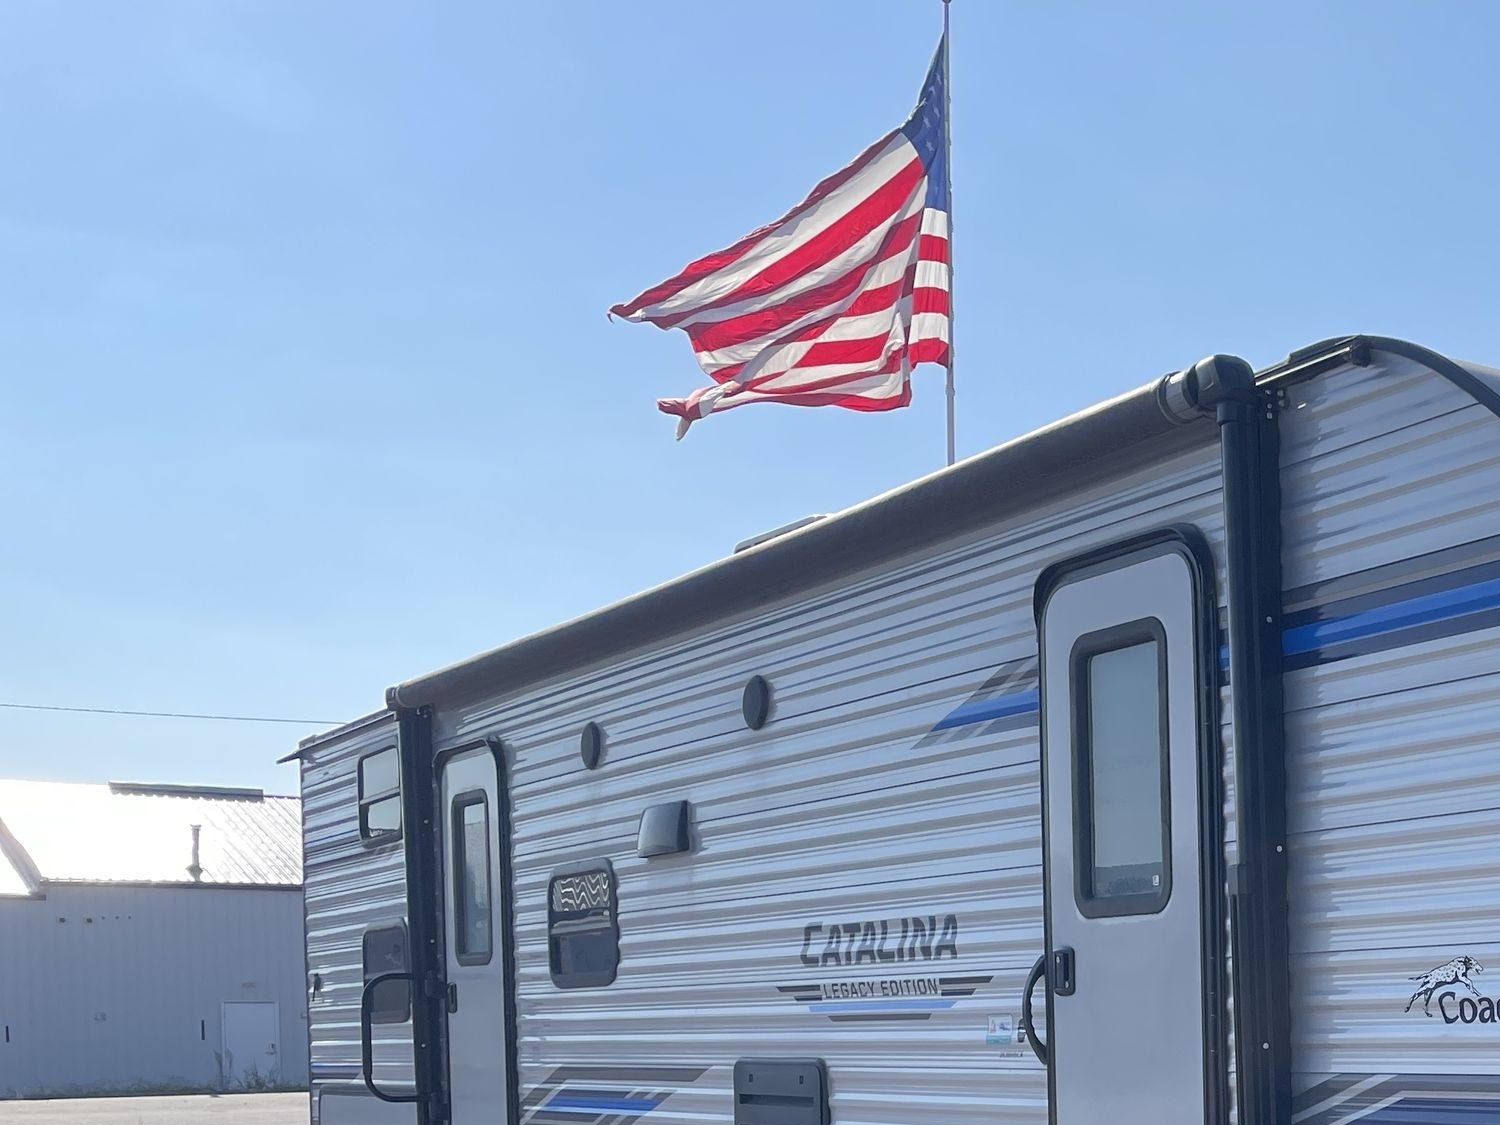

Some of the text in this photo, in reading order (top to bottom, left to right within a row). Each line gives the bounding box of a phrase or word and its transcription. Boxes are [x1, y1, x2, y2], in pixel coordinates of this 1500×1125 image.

[800, 914, 958, 967] CATALINA
[823, 978, 938, 999] LEGACY EDITION
